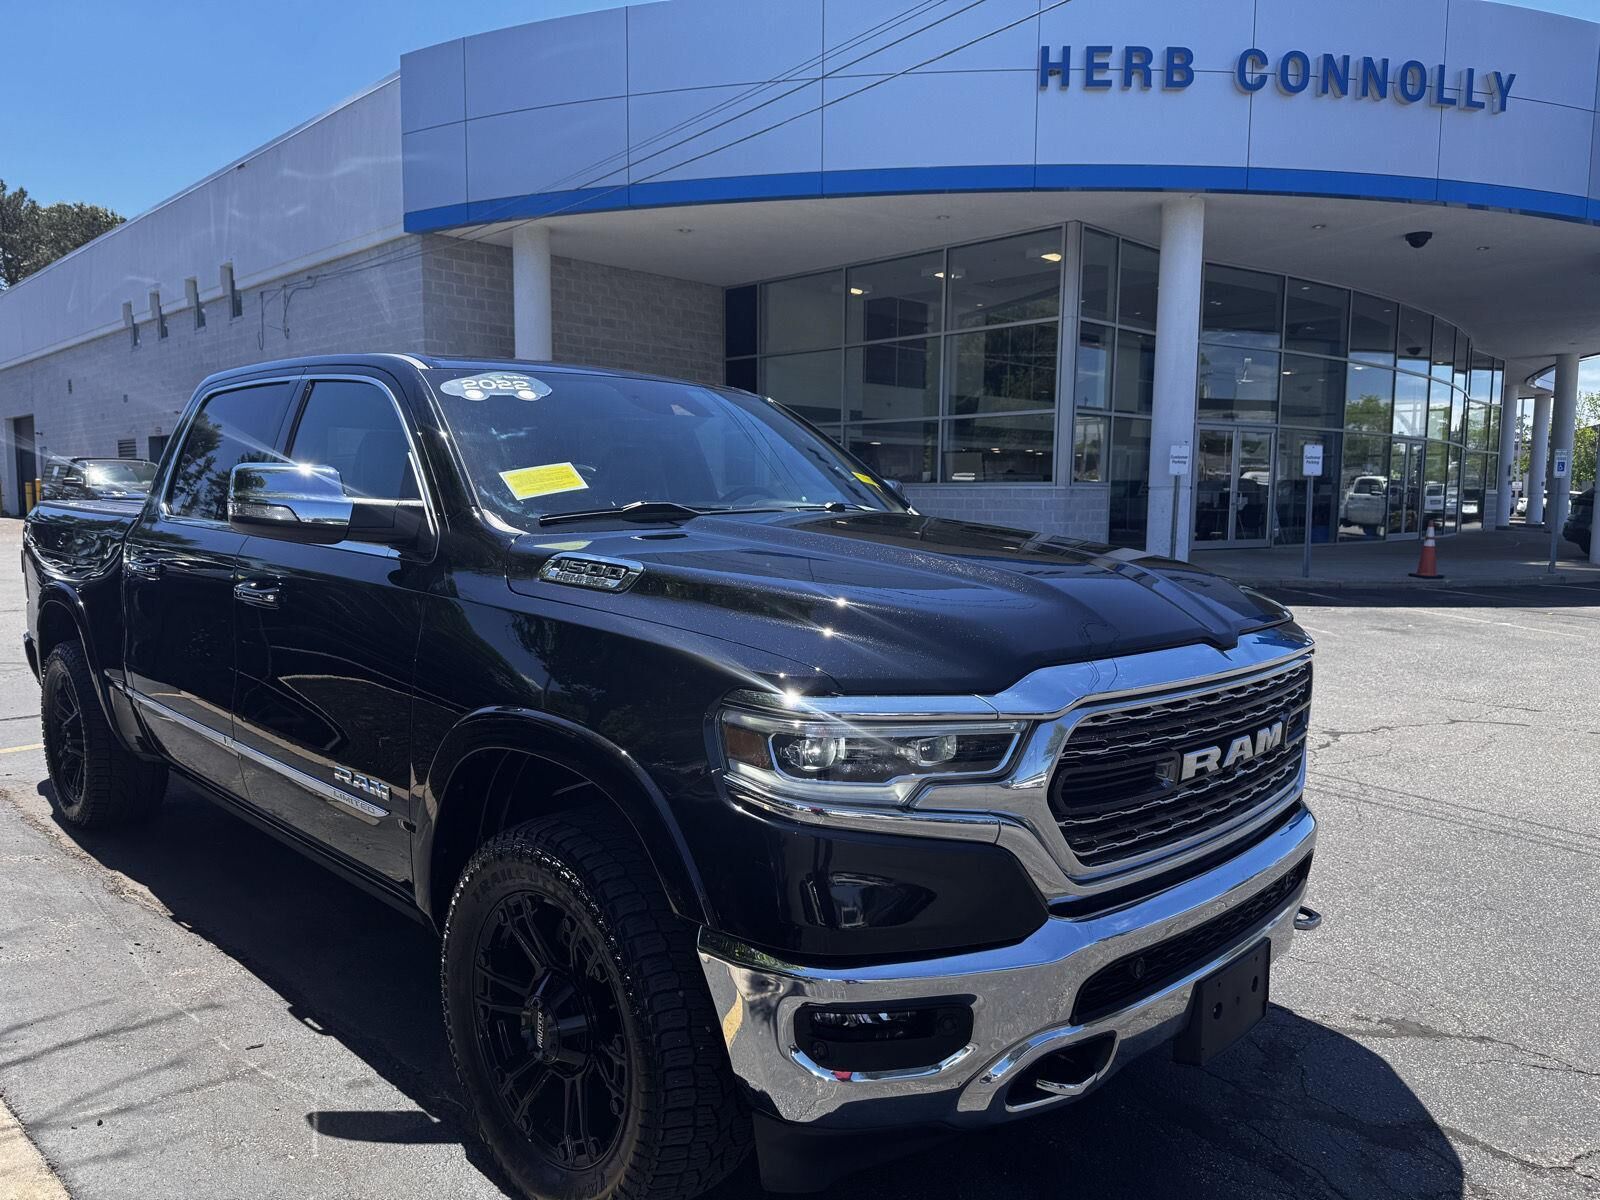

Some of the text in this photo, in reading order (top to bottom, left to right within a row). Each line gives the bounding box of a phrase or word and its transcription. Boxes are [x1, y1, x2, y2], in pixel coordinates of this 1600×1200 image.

[1039, 45, 1517, 115] HERB CONNOLLY
[461, 379, 532, 390] 2022
[559, 559, 626, 580] 1500
[1181, 721, 1283, 781] RAM
[333, 766, 391, 802] RAM
[333, 790, 376, 814] LIMITED
